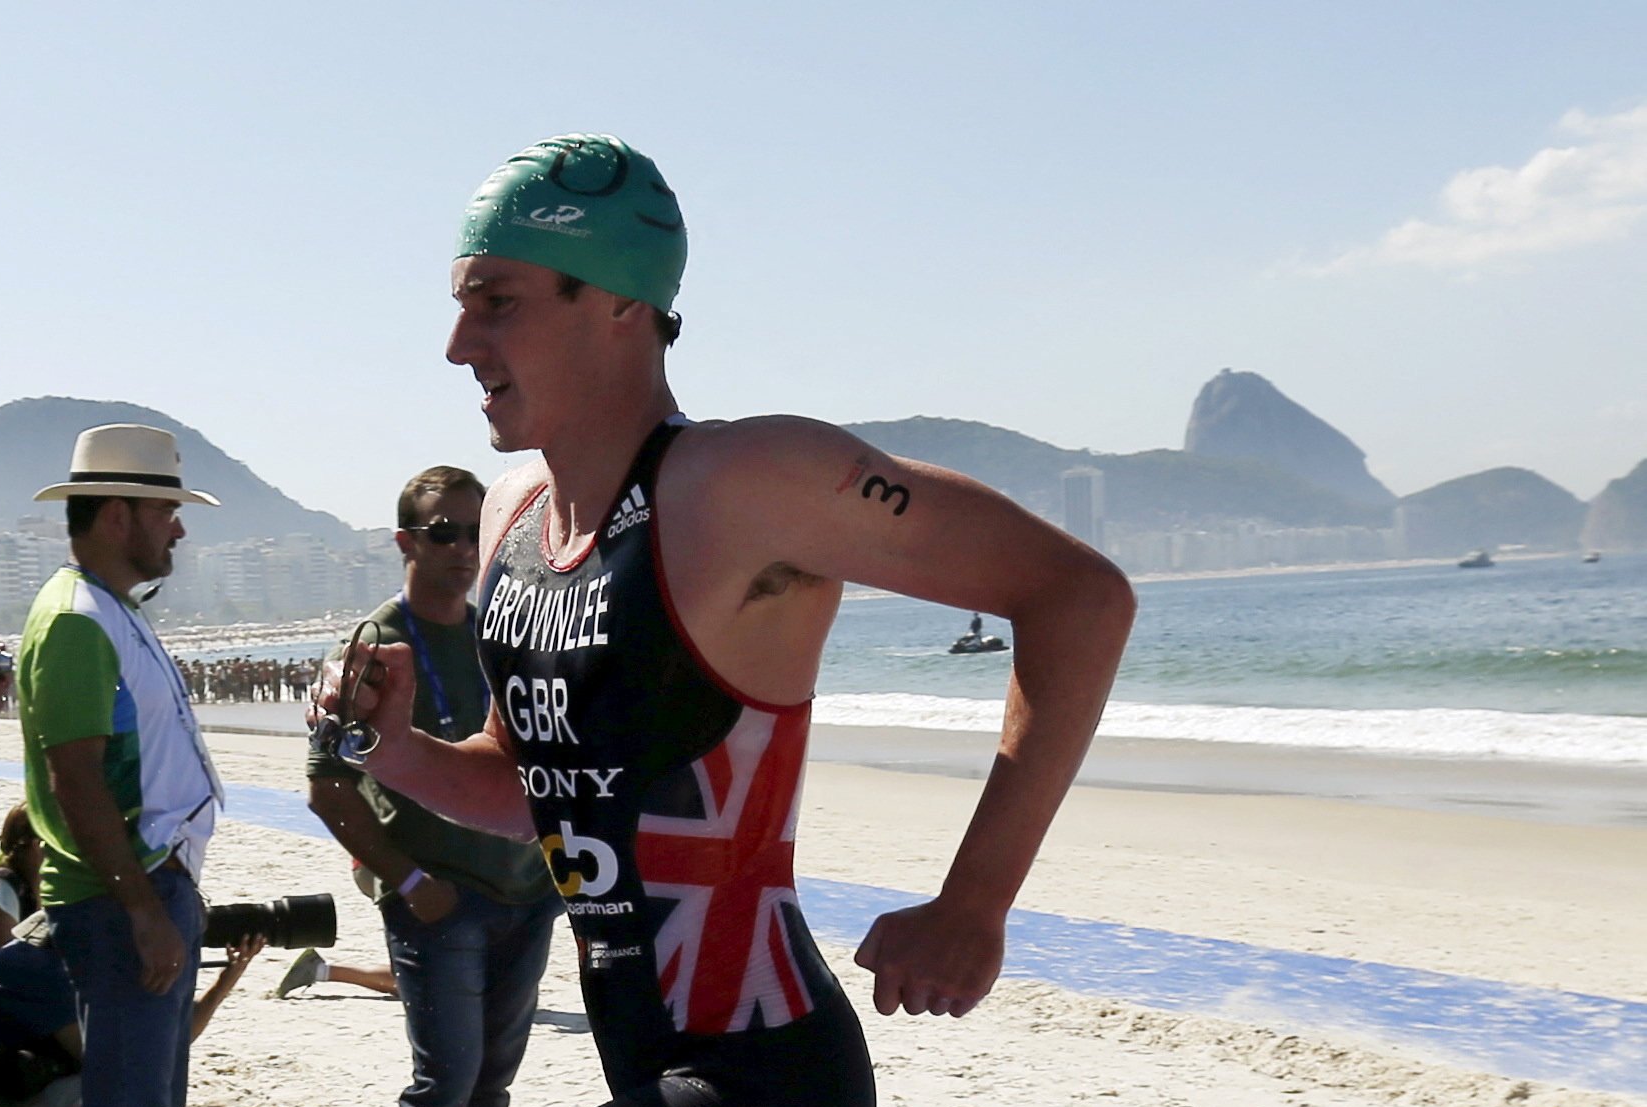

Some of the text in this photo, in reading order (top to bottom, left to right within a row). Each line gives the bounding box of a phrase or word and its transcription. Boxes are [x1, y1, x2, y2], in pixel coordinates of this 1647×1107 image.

[607, 508, 650, 538] adidas
[862, 475, 910, 516] 3
[482, 571, 613, 652] BROWNLEE
[506, 675, 579, 744] GBR
